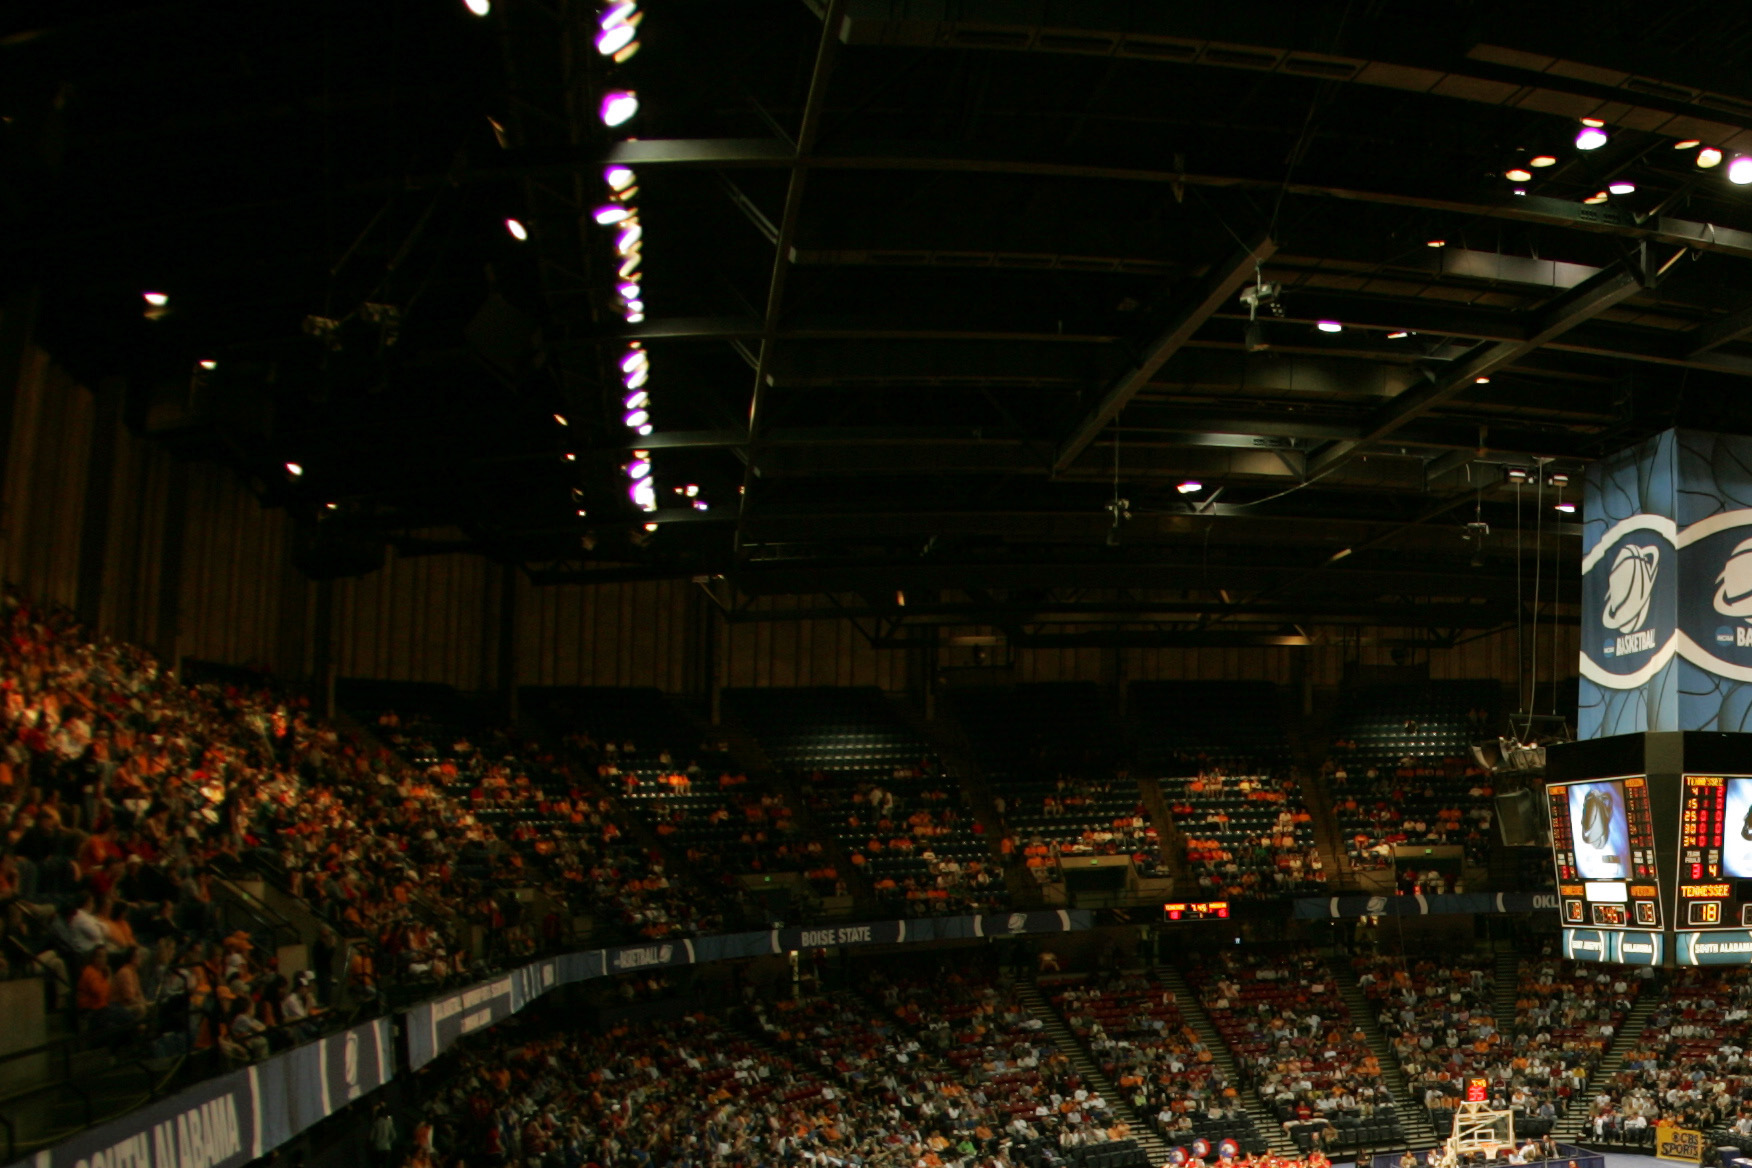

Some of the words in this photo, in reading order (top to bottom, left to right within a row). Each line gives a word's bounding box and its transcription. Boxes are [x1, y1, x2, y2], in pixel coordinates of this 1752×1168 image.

[1681, 884, 1730, 898] TENNESSEE
[1701, 903, 1717, 921] 18
[801, 929, 836, 947] BOISE
[838, 926, 872, 943] STATE
[1694, 943, 1719, 954] SOUTH
[1681, 1132, 1699, 1145] CBS
[1661, 1142, 1699, 1157] SPORTS
